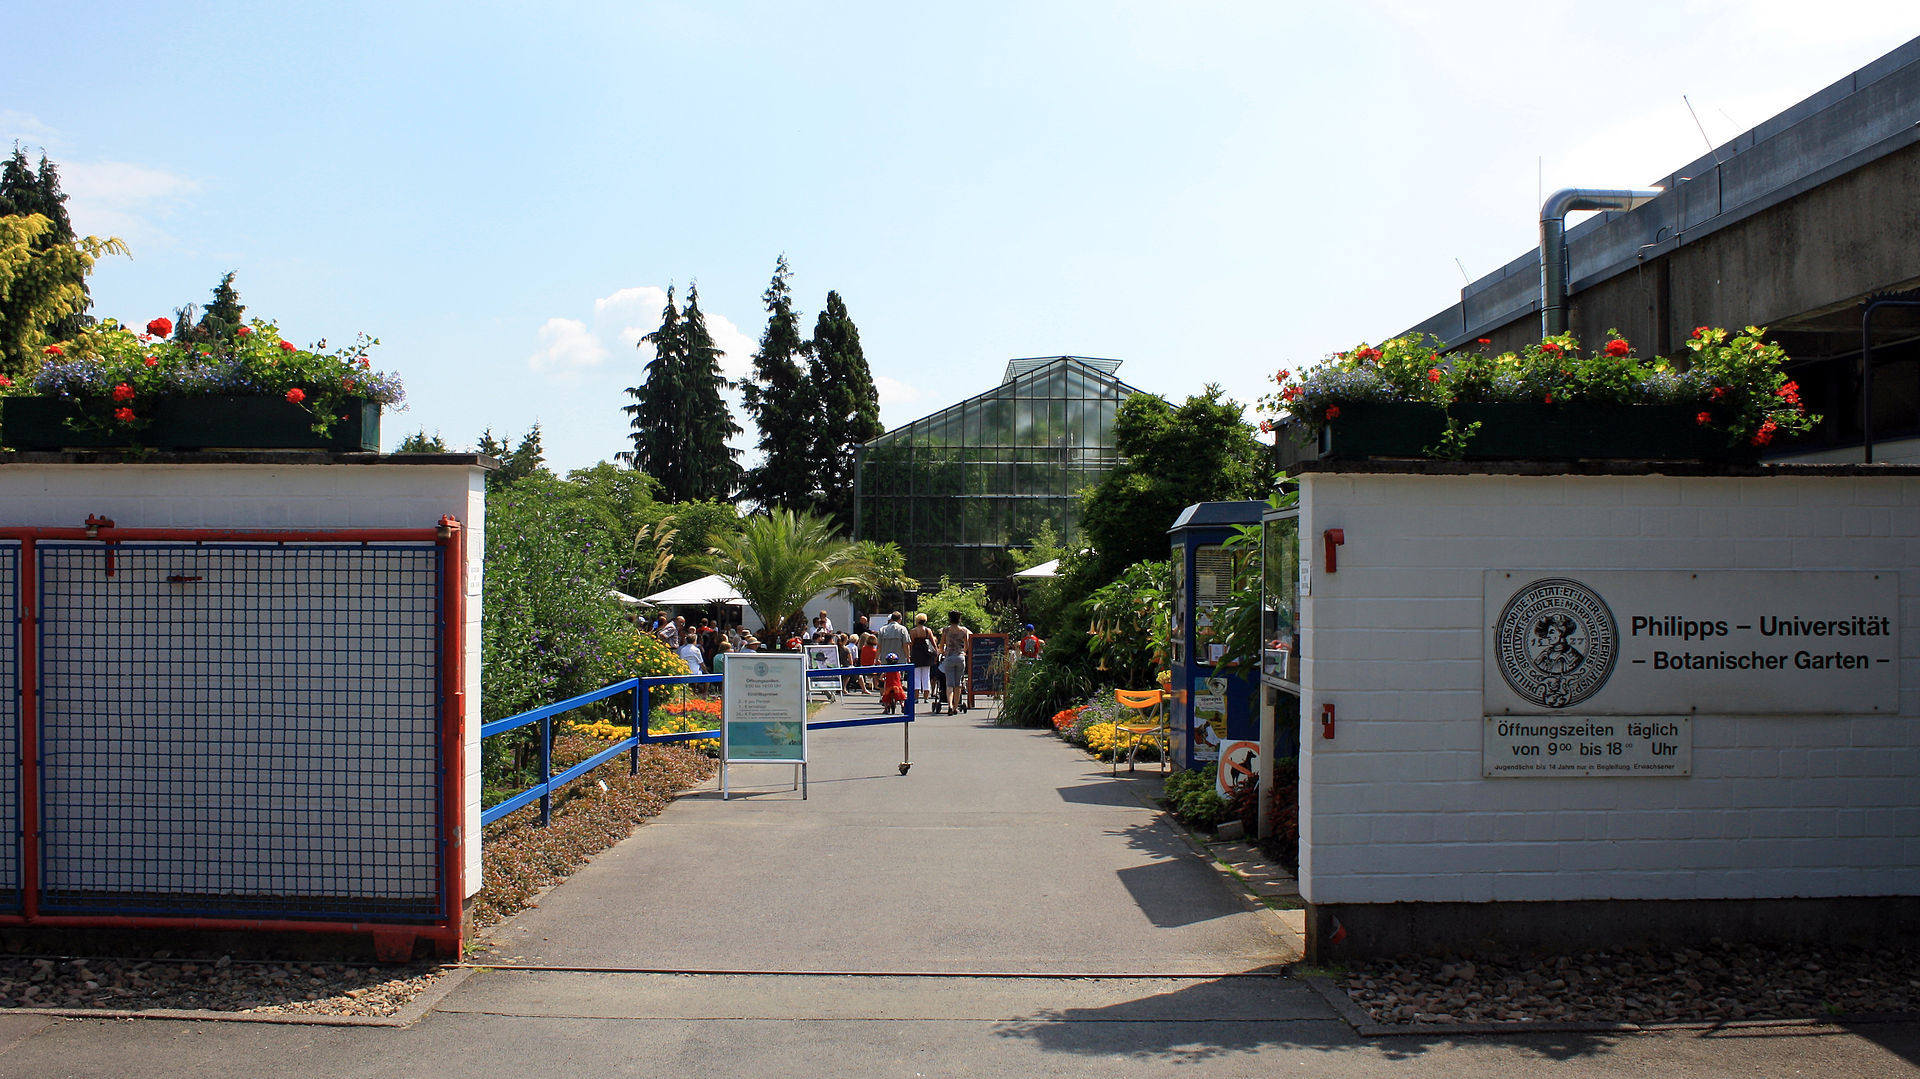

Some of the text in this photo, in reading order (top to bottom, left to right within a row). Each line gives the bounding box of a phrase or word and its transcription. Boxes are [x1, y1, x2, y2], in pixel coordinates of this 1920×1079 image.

[1631, 615, 1729, 641] Philipps
[1759, 615, 1891, 637] Universität
[1653, 650, 1789, 670] Botanischer
[1793, 650, 1870, 670] Garten
[1497, 720, 1679, 740] Öffnungszeiten täglich
[1511, 745, 1540, 756] von
[1579, 741, 1603, 756] bis
[1651, 741, 1679, 756] Uhr
[1536, 763, 1546, 771] bis
[1633, 763, 1676, 771] Erwachsener
